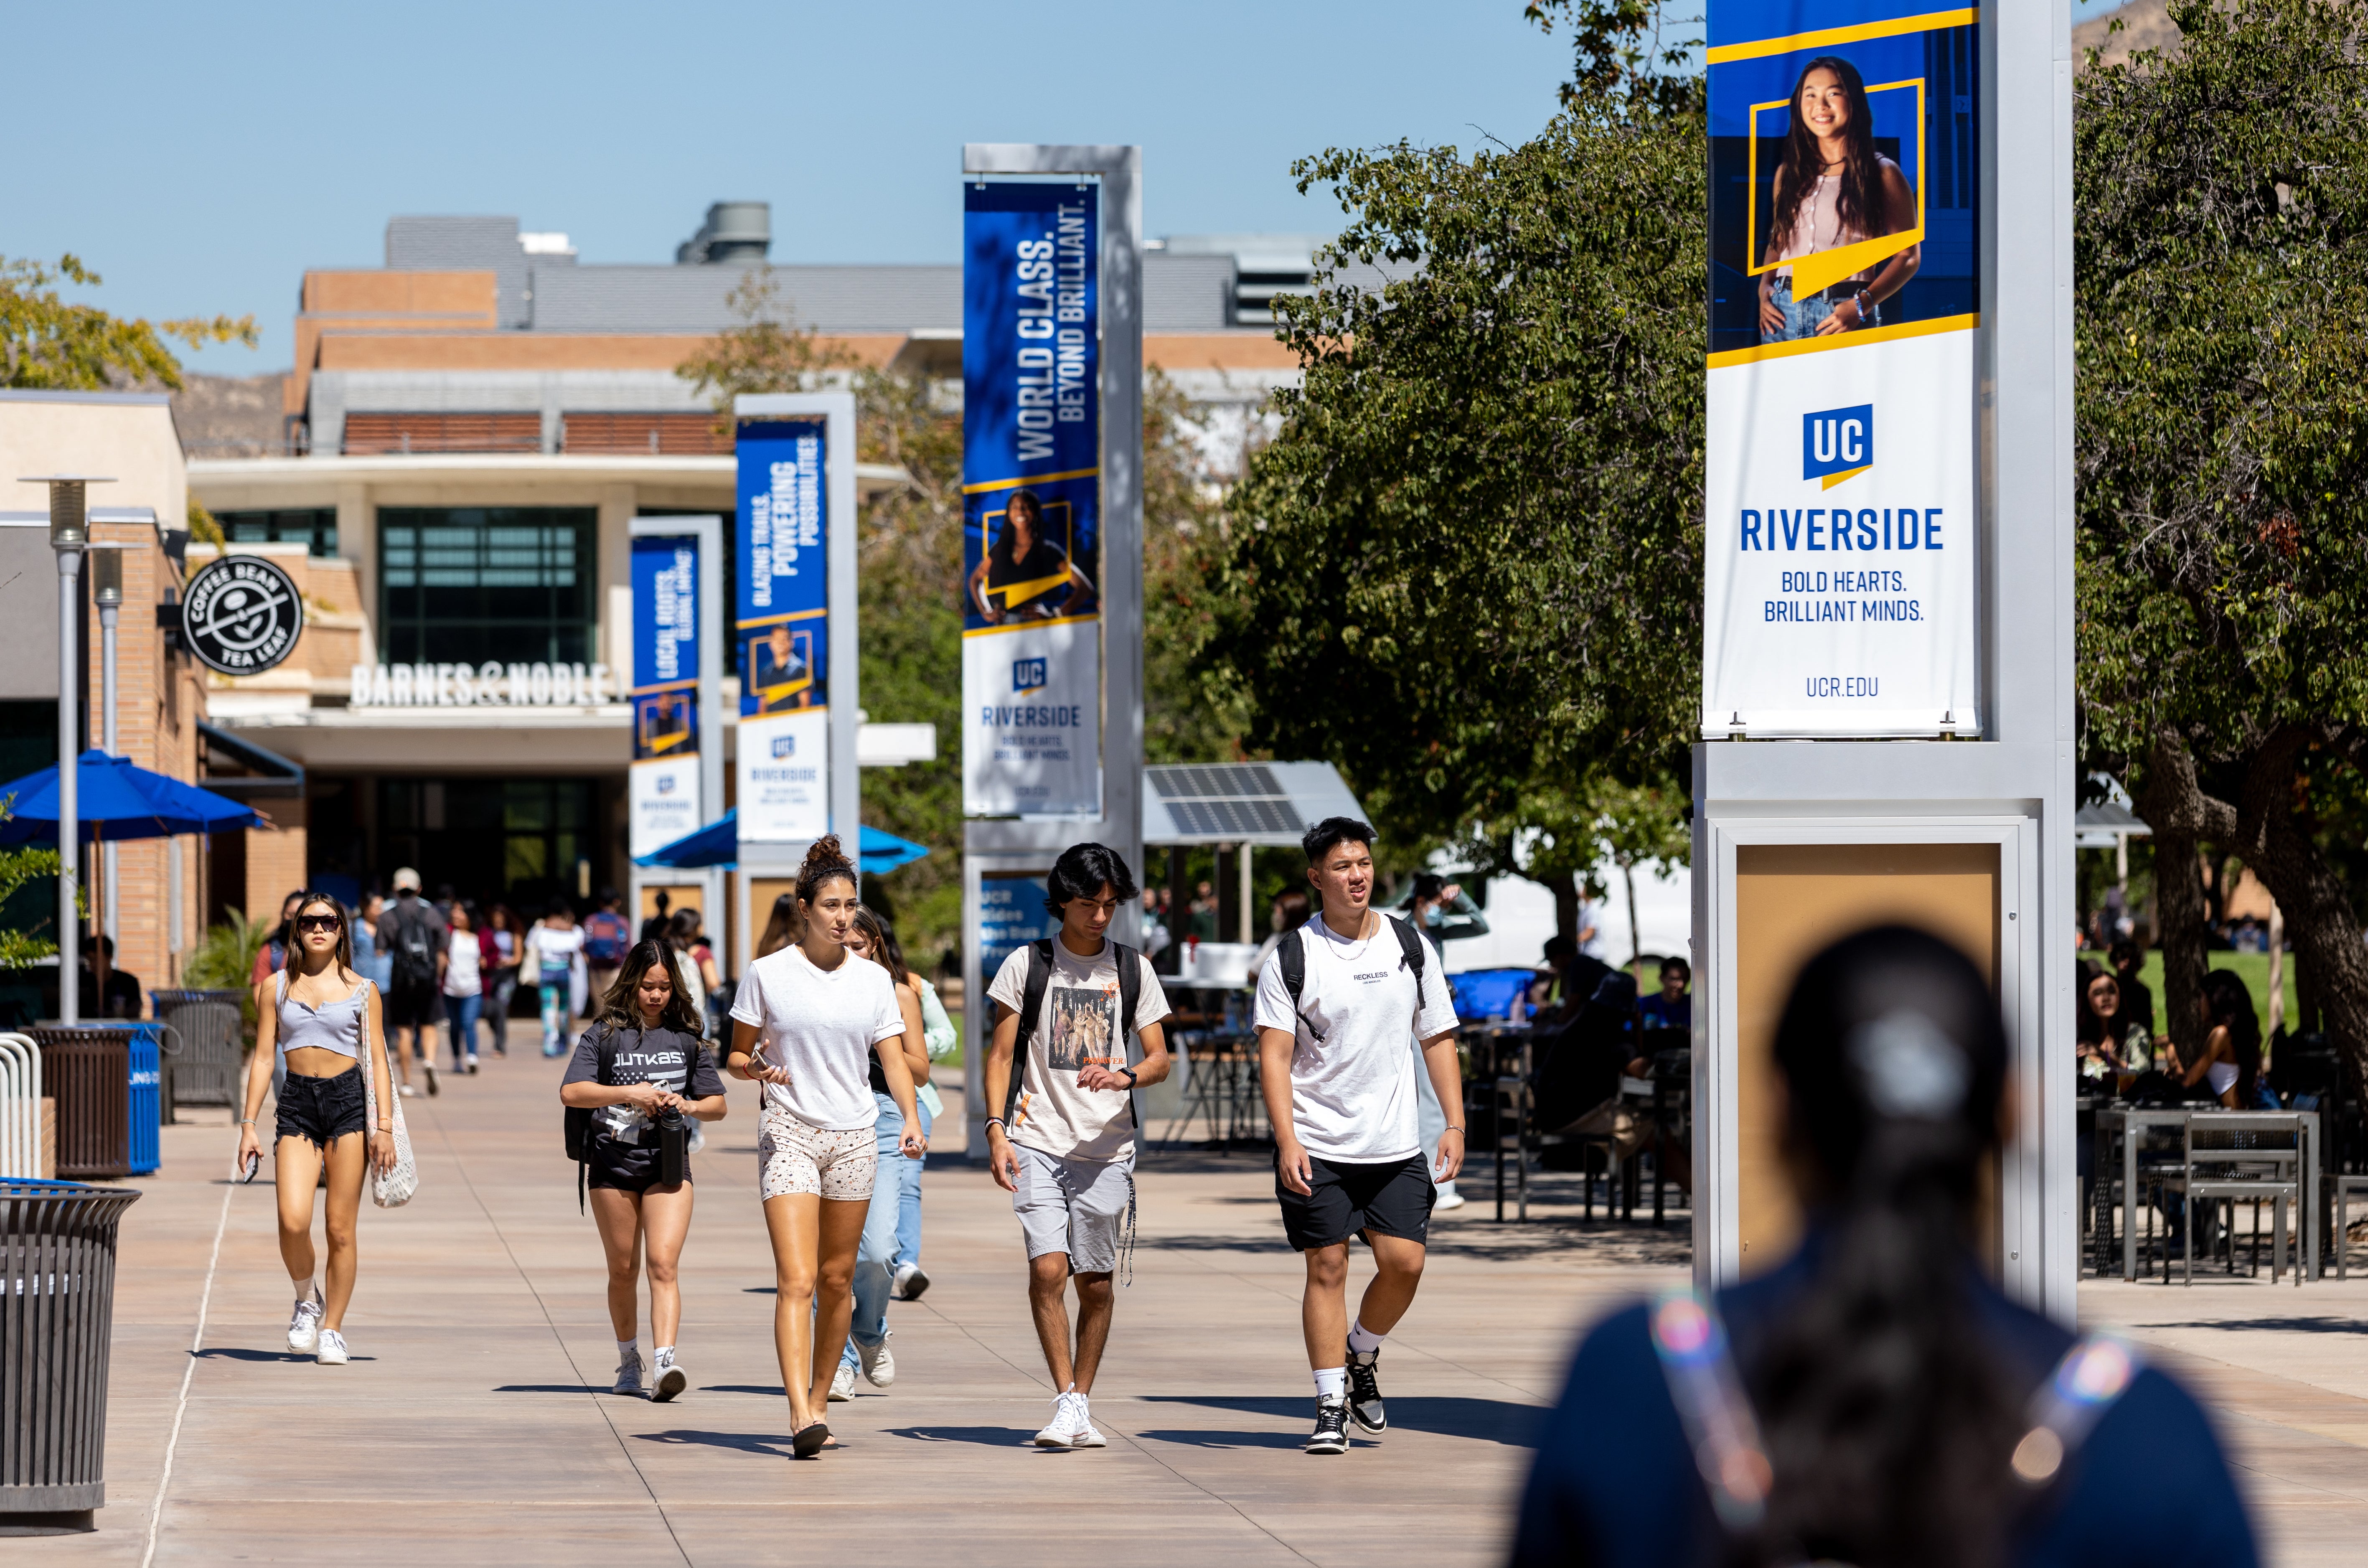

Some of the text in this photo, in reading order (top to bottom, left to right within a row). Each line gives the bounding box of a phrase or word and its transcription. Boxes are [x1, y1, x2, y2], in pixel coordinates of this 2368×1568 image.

[1057, 199, 1085, 422] BEYOND BRILLIANT.
[1017, 231, 1054, 461] WORLD CLASS.
[1814, 419, 1862, 462] UC
[770, 461, 798, 576] POWERING
[1741, 508, 1943, 551] RIVERSIDE
[191, 564, 281, 623] COFFEE BEAN
[1782, 571, 1907, 592] BOLD HEARTS.
[1765, 600, 1923, 622] BRILLIANT MINDS.
[222, 625, 288, 666] TEA LEAF
[351, 663, 474, 706] BARNES
[506, 662, 610, 706] NOBLE
[1017, 663, 1042, 685] UC
[1806, 677, 1878, 697] UCR.EDU
[982, 706, 1081, 727] RIVERSIDE
[1354, 972, 1388, 980] RECKLESS
